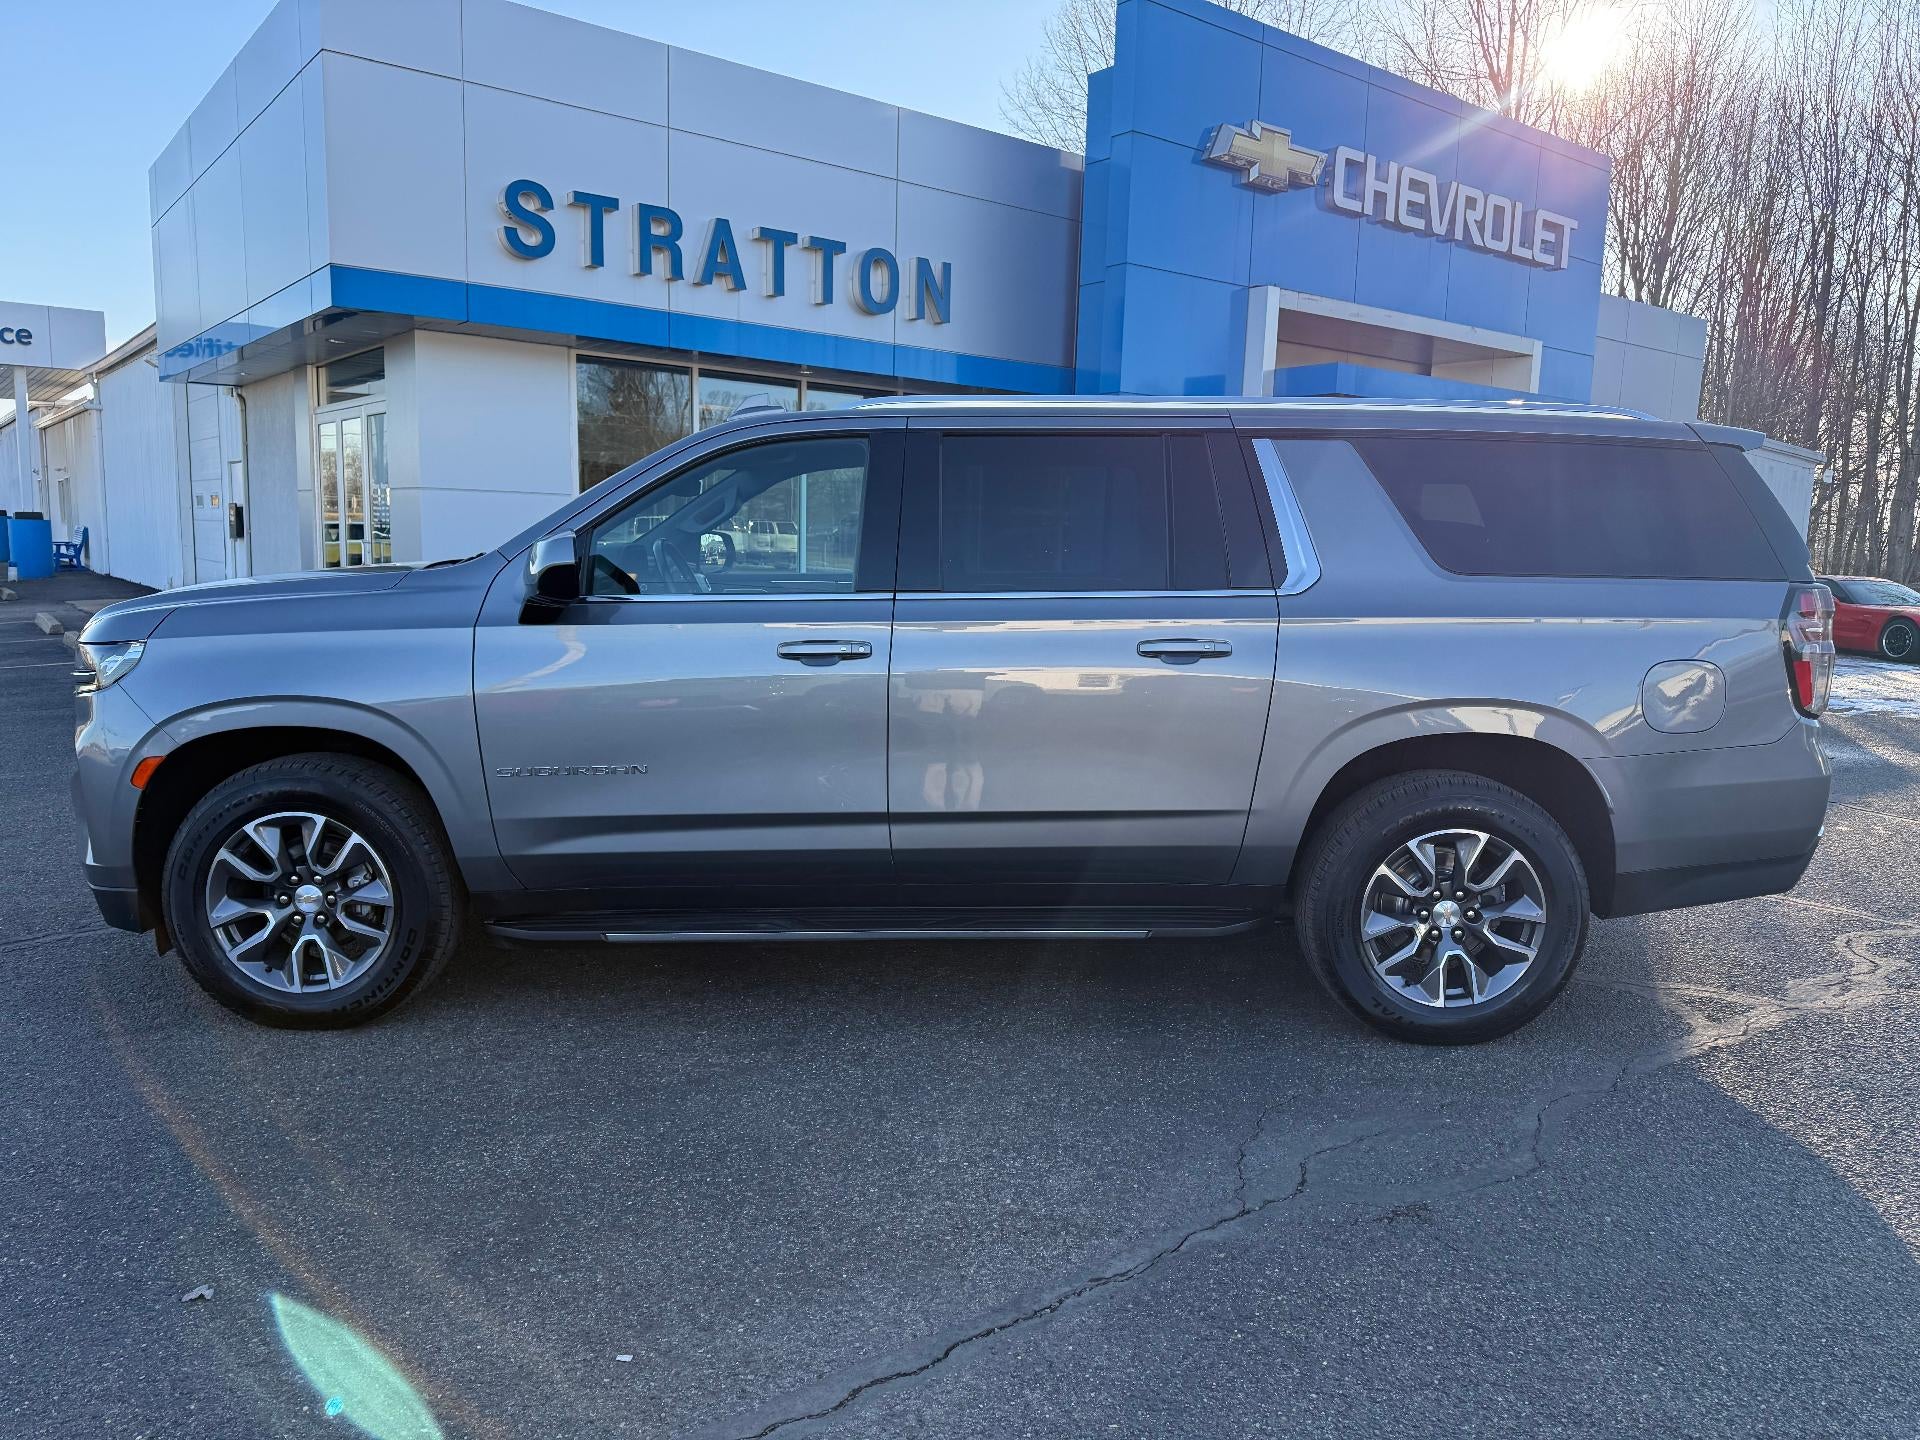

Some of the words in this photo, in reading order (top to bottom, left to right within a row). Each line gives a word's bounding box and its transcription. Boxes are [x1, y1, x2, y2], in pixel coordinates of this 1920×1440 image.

[1331, 145, 1579, 270] CHEVROLET
[498, 179, 951, 324] STRATTON
[0, 327, 33, 346] ce
[496, 764, 649, 777] SUBURBAN
